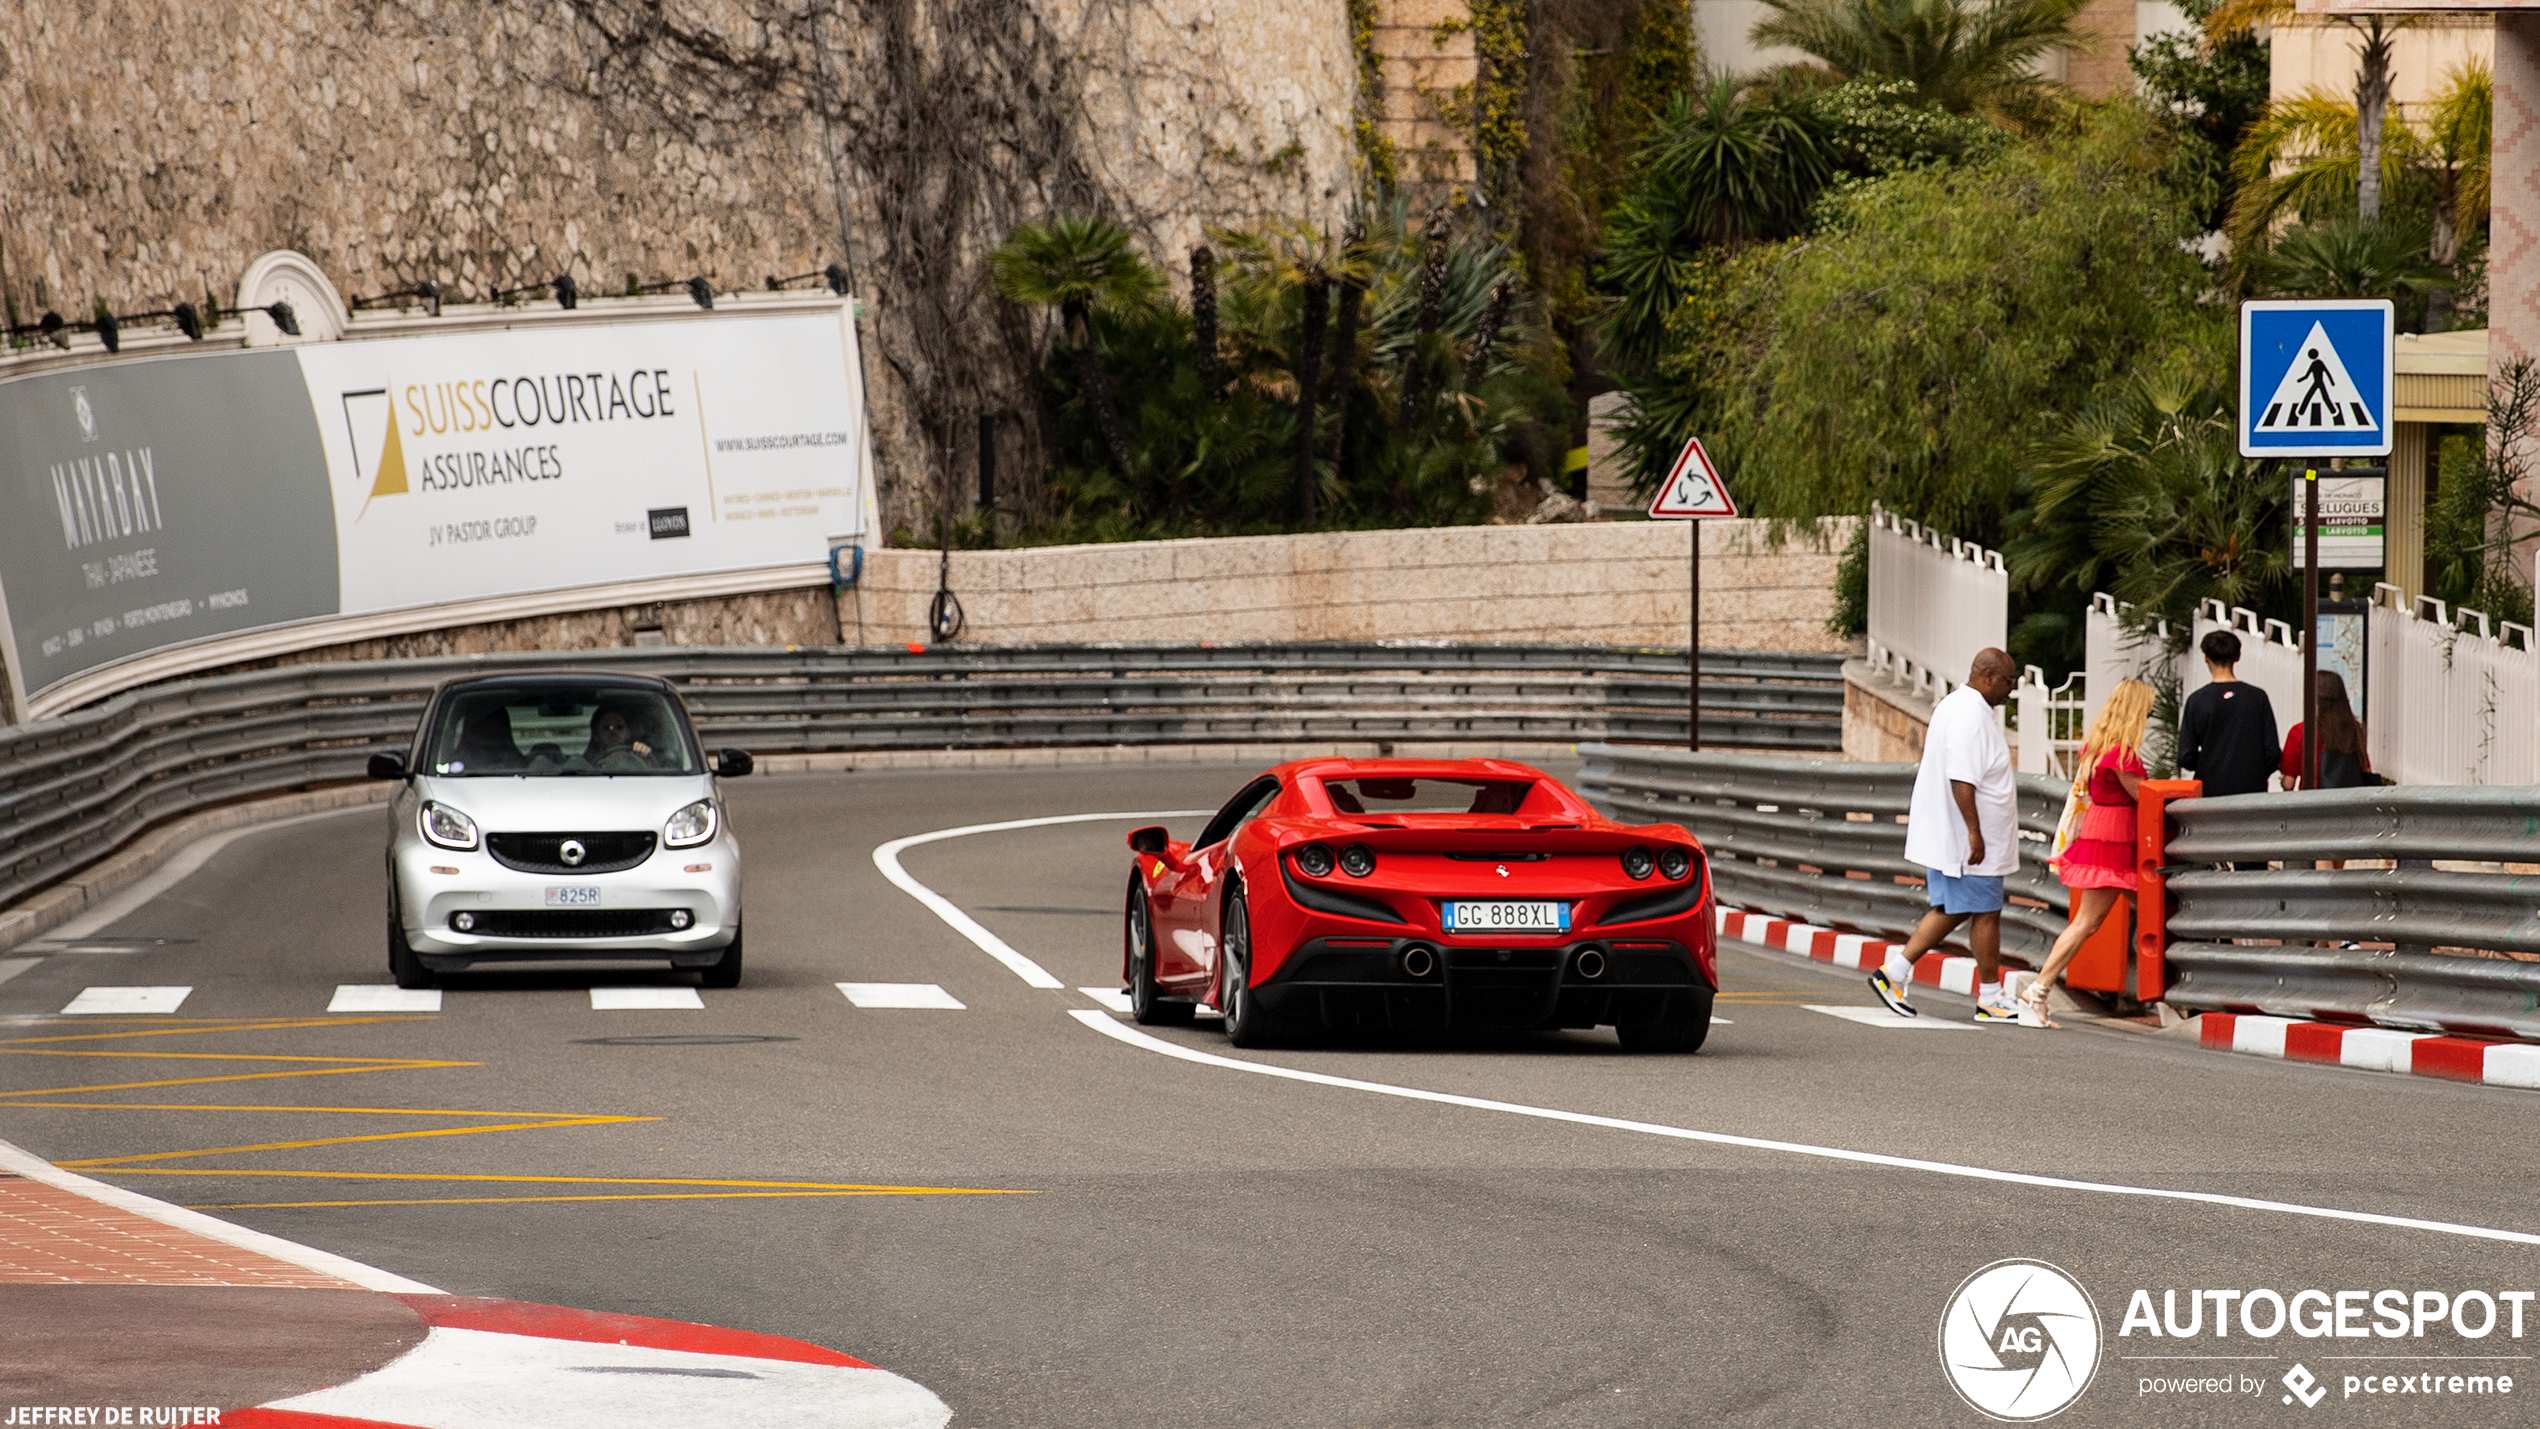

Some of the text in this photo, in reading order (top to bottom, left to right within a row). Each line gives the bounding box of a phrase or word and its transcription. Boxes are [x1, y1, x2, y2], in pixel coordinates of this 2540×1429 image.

[406, 368, 674, 436] SUISSCOURTAGE
[715, 432, 848, 452] WWW.SUISSCOURTAGE.COM
[421, 443, 562, 492] ASSURANCES
[50, 446, 162, 550] MAYABAY
[2301, 503, 2379, 514] SELUGUES
[446, 520, 492, 544] PASTOR
[494, 515, 538, 539] GROUP
[559, 888, 597, 903] 825R
[1491, 905, 1554, 925] 888XL
